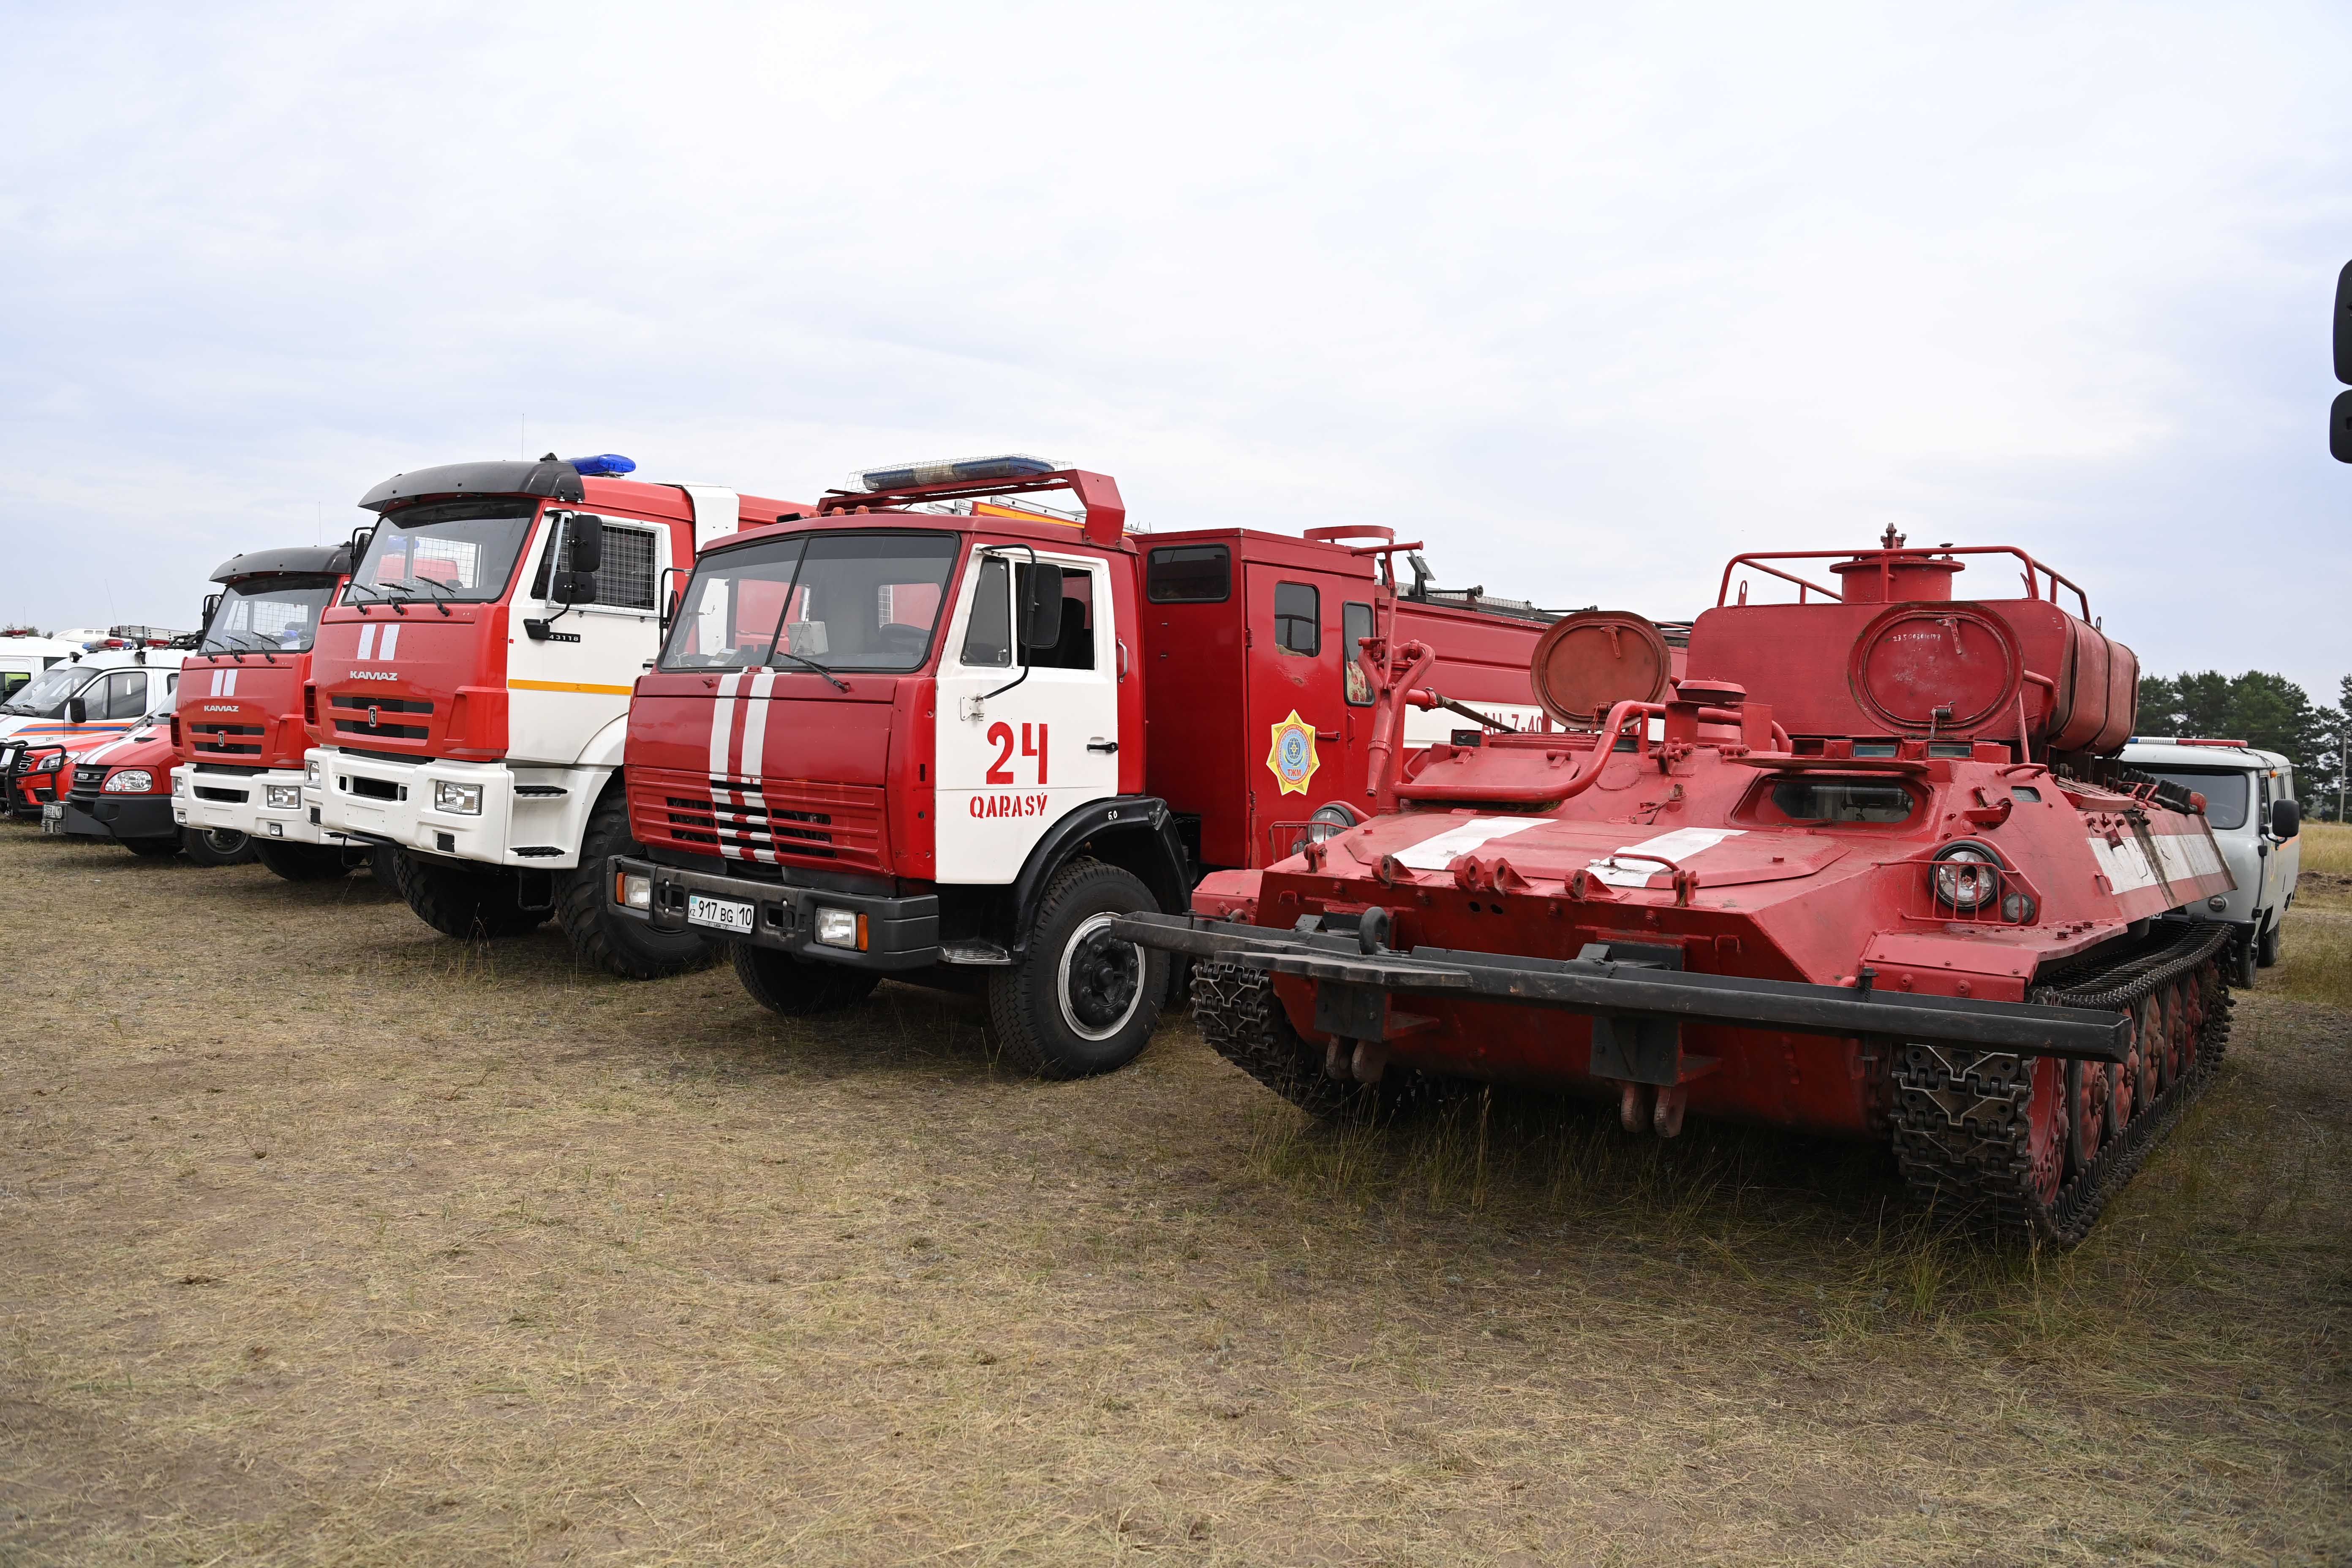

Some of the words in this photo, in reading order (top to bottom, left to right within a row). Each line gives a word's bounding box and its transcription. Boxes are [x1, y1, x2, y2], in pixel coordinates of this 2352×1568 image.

[350, 670, 398, 681] KAMAZ
[986, 721, 1048, 784] 24
[970, 792, 1048, 819] QARASÝ
[689, 908, 696, 916] KZ
[699, 900, 717, 920] 917
[720, 908, 733, 923] BG
[739, 907, 752, 926] 10
